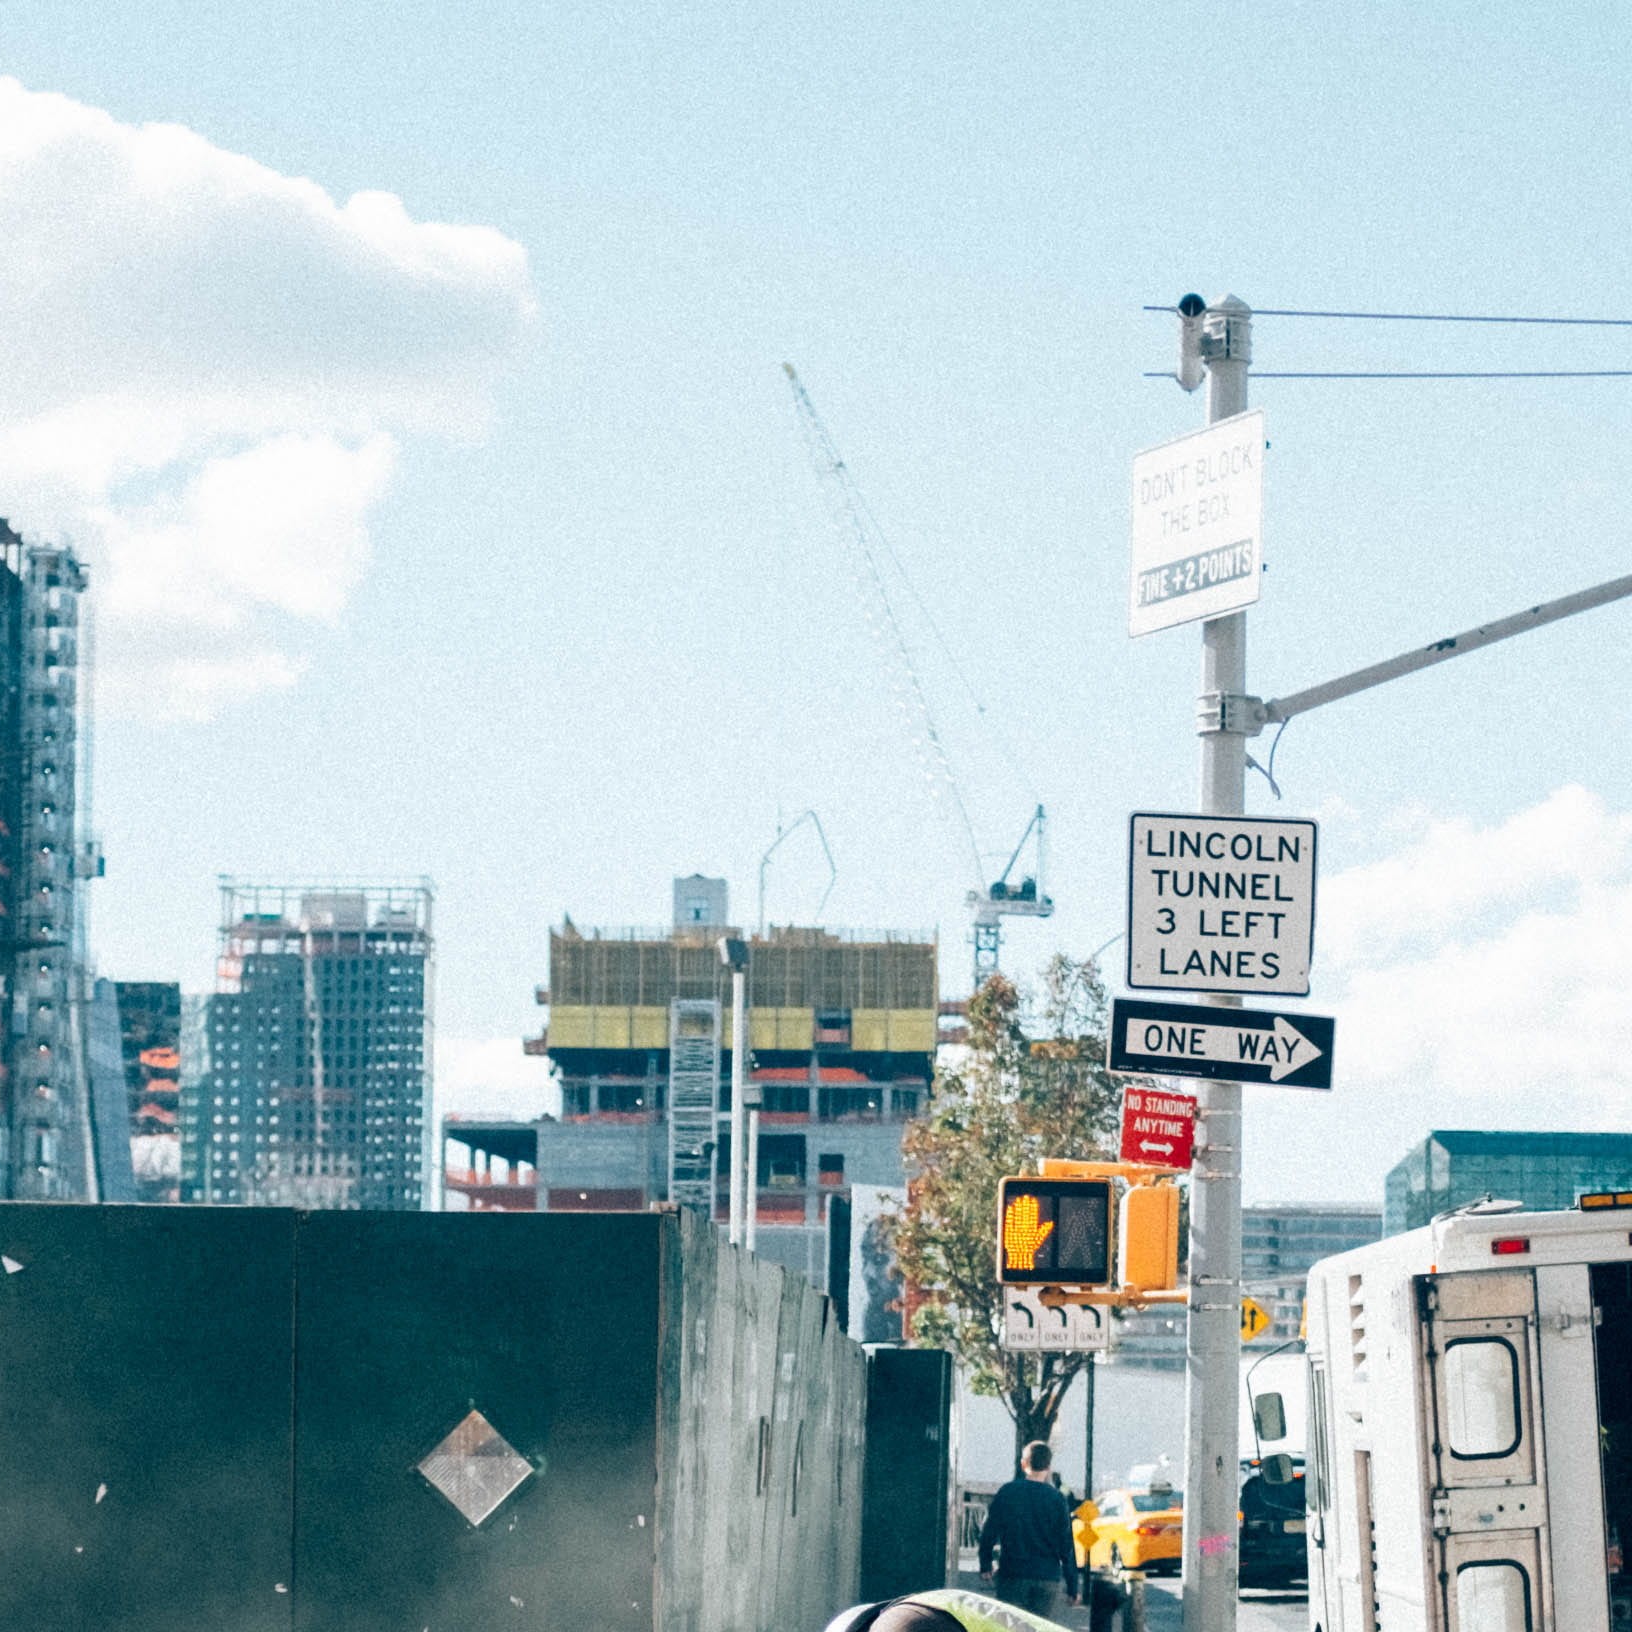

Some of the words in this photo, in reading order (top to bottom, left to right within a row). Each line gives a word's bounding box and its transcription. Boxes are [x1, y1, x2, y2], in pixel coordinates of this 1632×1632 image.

[1140, 464, 1186, 505] DON'T
[1196, 443, 1254, 486] BLOCK
[1161, 505, 1189, 536] THE
[1198, 494, 1230, 526] BOX
[1139, 568, 1169, 605] FINE
[1198, 545, 1252, 587] POINTS
[1147, 829, 1299, 862] LINCOLN
[1151, 869, 1294, 901] TUNNEL
[1156, 908, 1176, 934] 3
[1199, 910, 1286, 939] LEFT
[1160, 948, 1280, 979] LANES
[1144, 1024, 1206, 1055] ONE
[1238, 1032, 1300, 1064] WAY
[1128, 1094, 1141, 1111] NO
[1145, 1097, 1193, 1118] STANDING
[1134, 1117, 1184, 1137] ANYTIME
